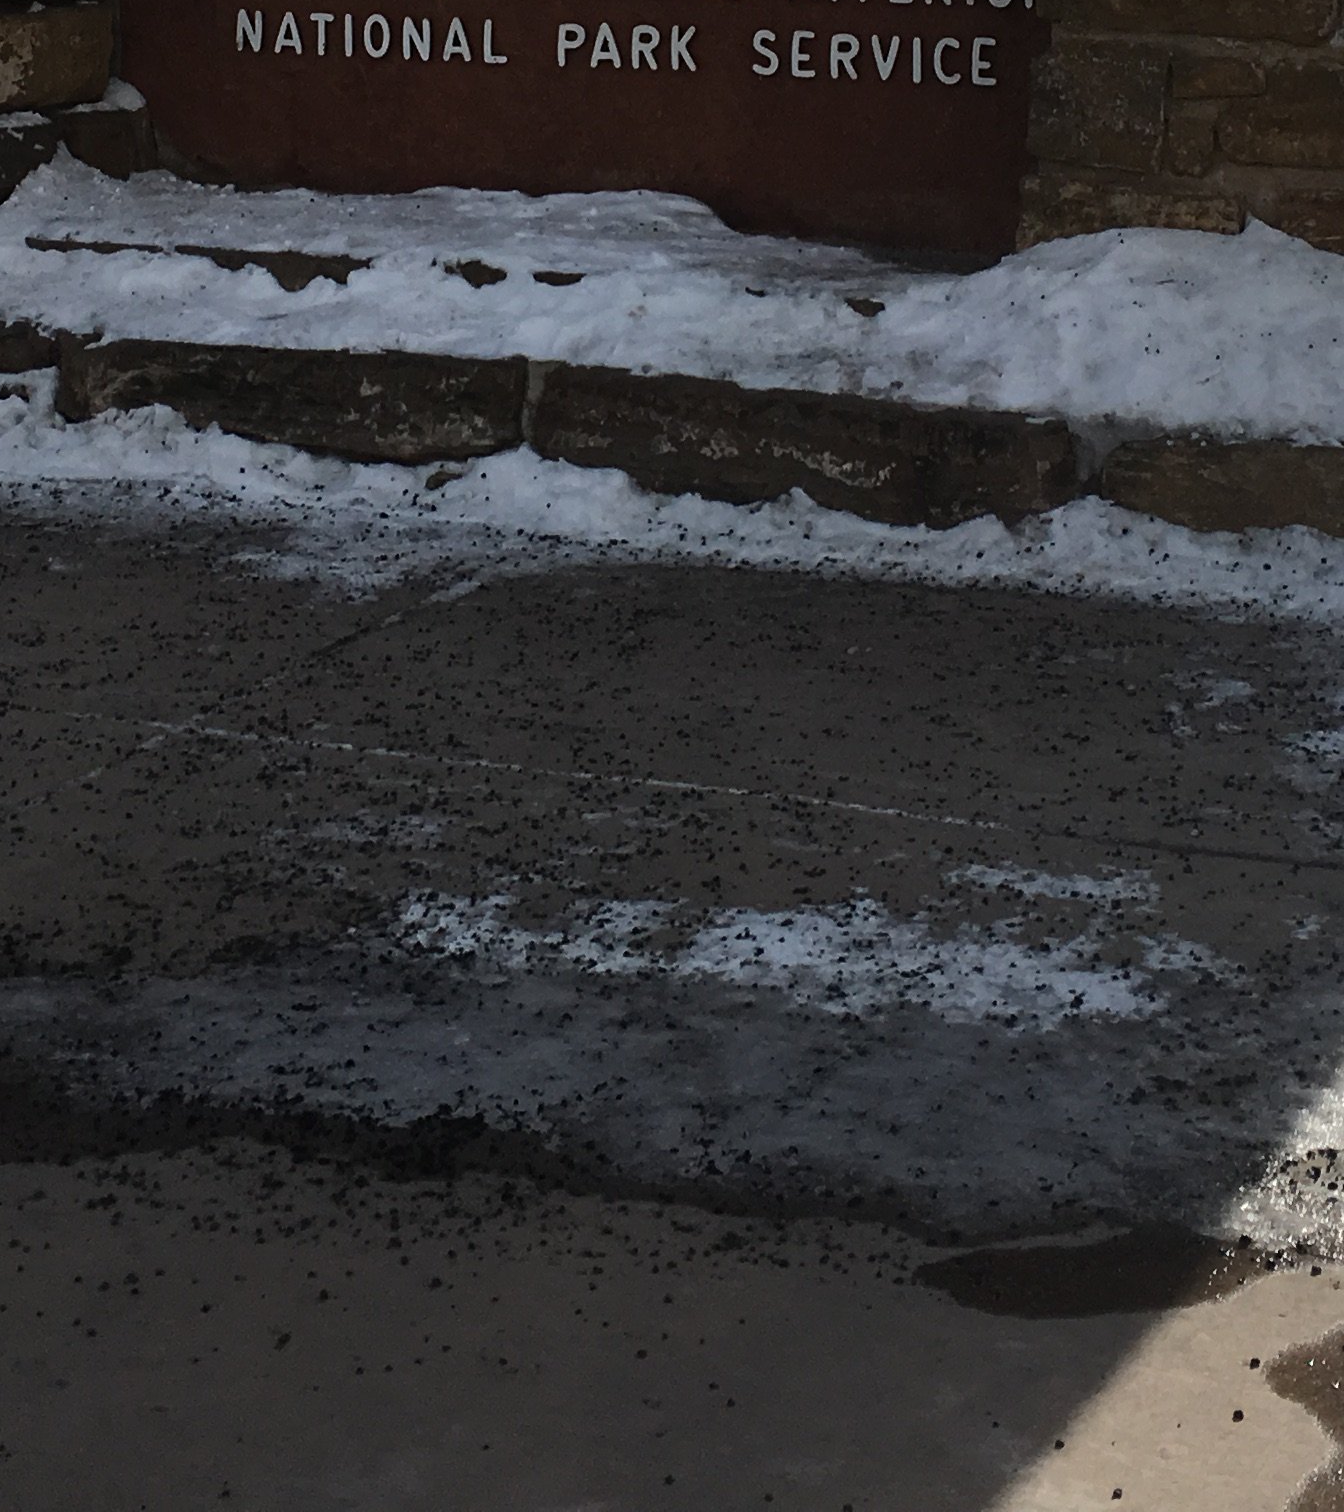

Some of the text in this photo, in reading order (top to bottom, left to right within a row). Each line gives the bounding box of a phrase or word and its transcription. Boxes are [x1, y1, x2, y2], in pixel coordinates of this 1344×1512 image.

[236, 8, 997, 86] NATIONAL PARK SERVICE
